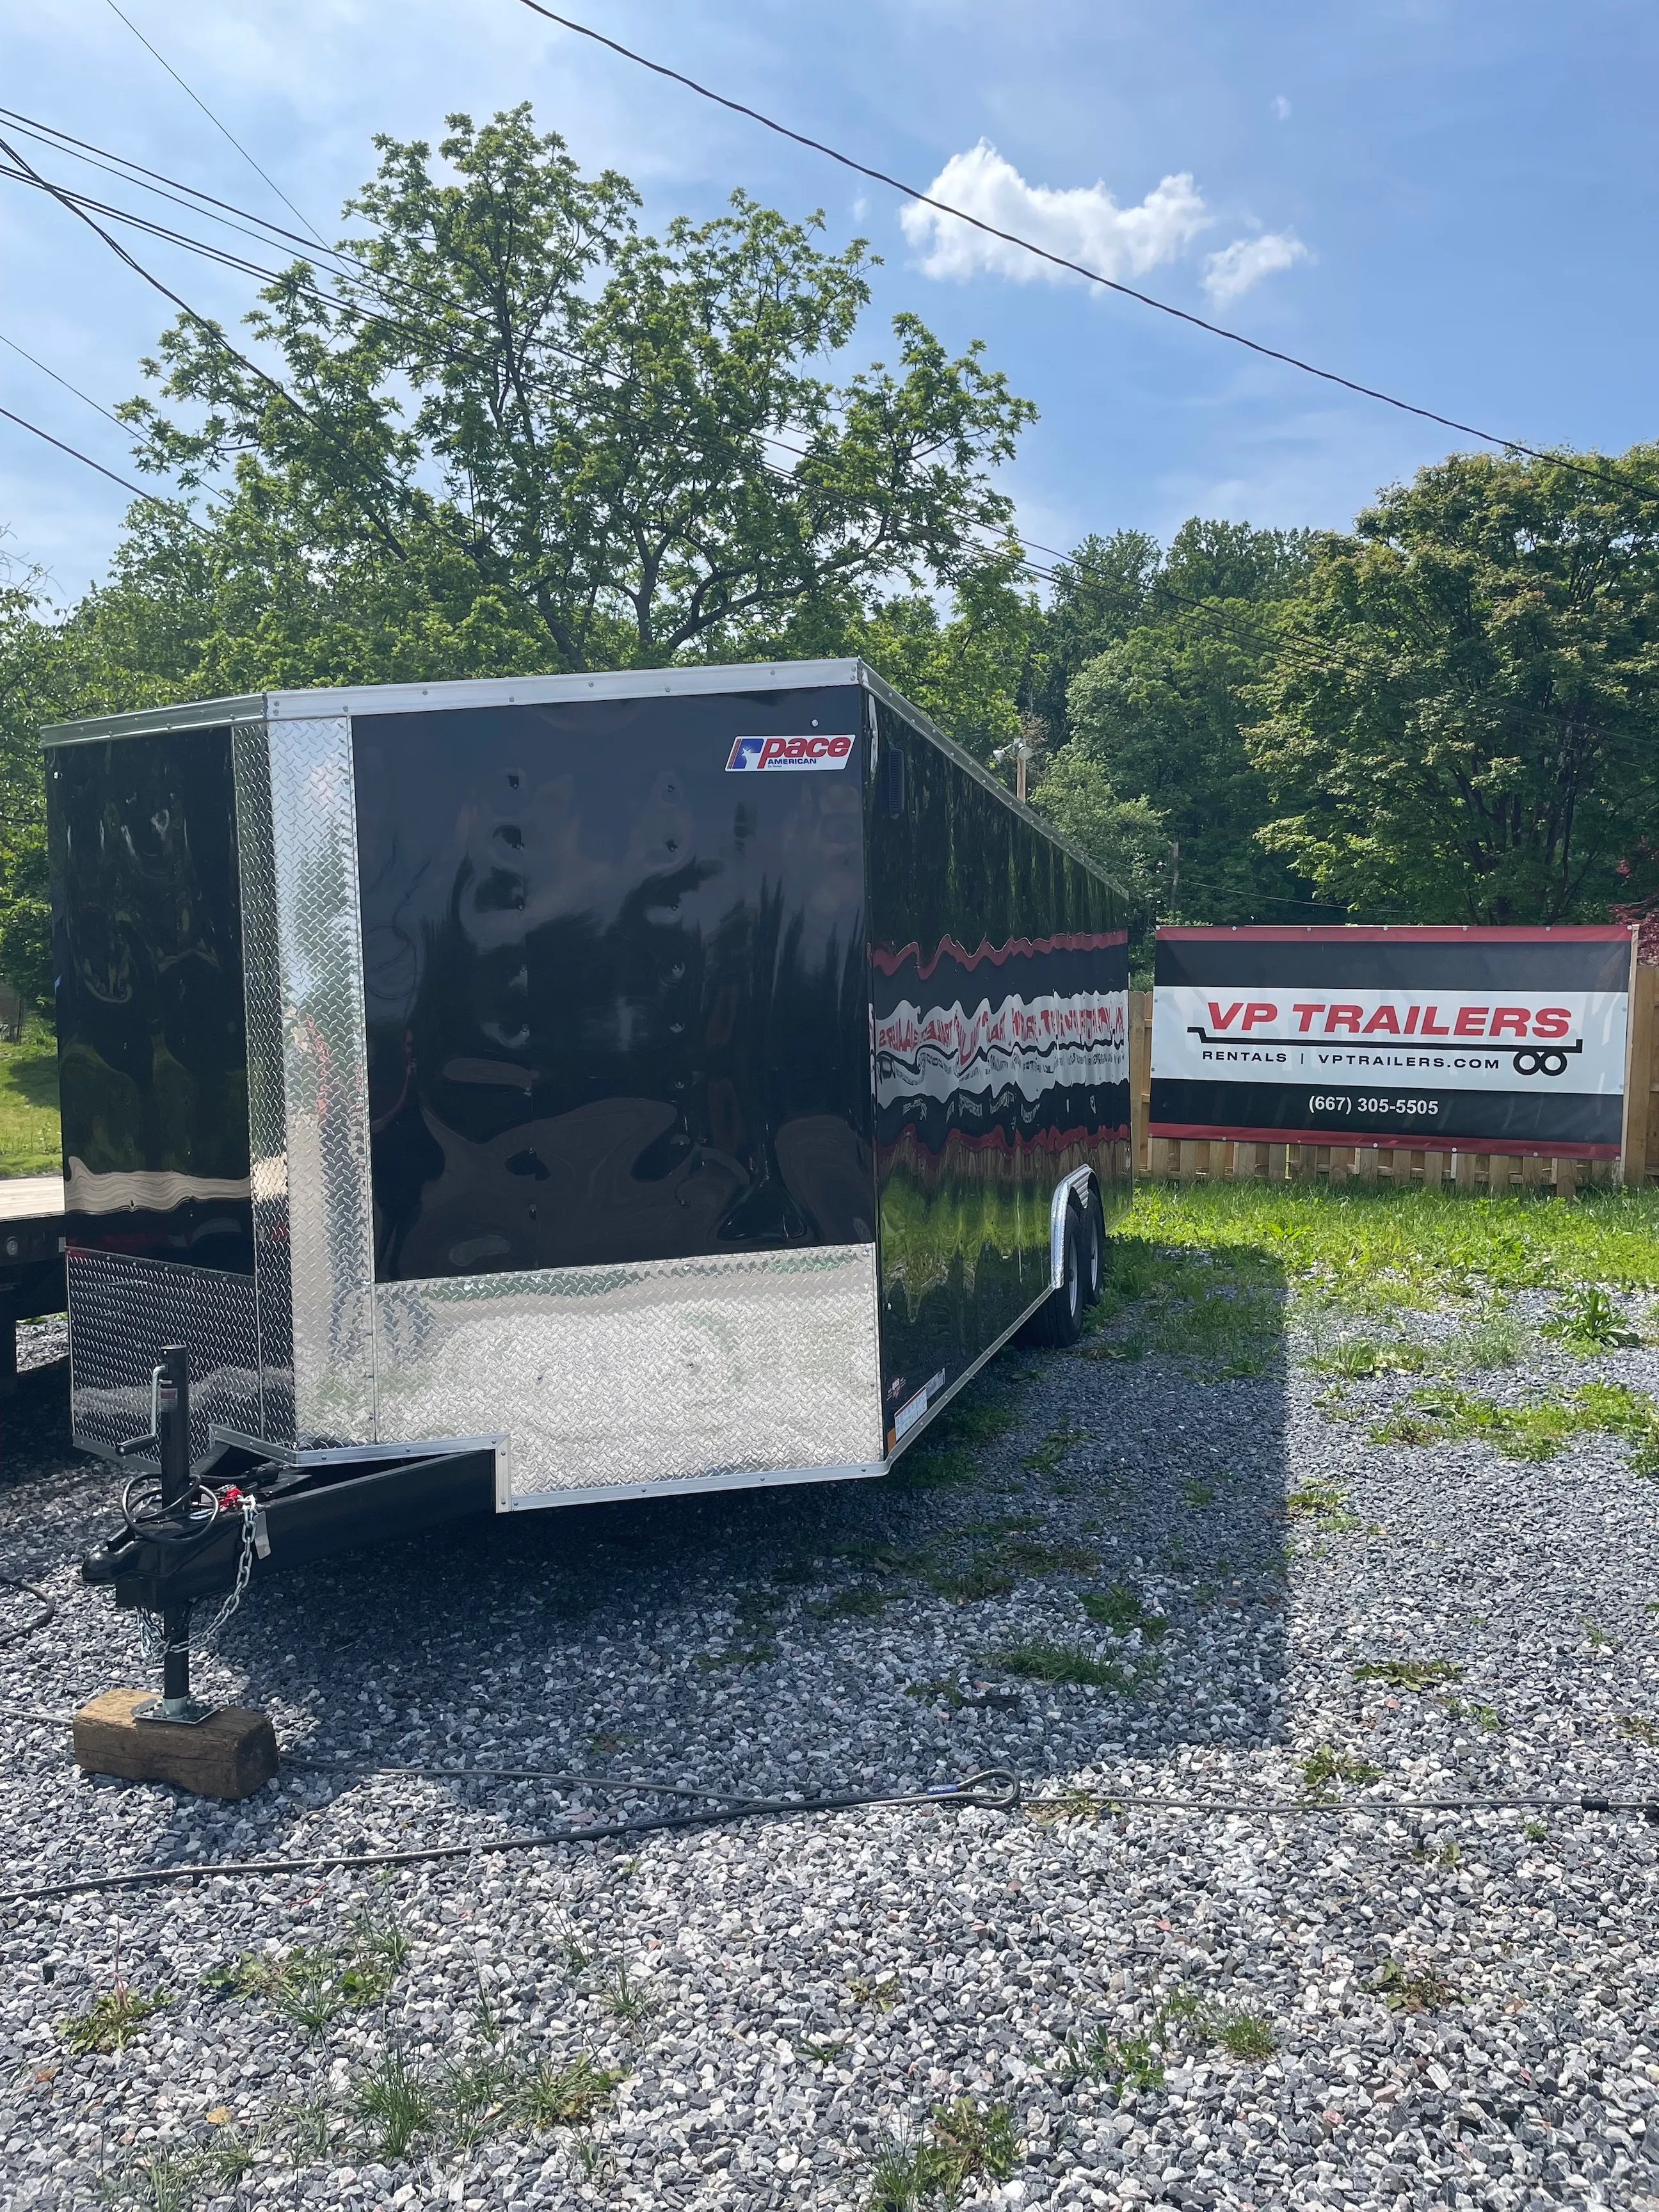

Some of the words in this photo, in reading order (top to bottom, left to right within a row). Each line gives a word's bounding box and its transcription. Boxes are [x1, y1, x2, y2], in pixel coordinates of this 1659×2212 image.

[757, 737, 851, 769] pace
[1207, 1002, 1278, 1030] VP
[1292, 1004, 1572, 1038] TRAILERS
[1202, 1050, 1287, 1062] RENTALS
[1318, 1054, 1500, 1070] VPTRAILERS.COM
[1308, 1095, 1352, 1115] (667)
[1357, 1097, 1439, 1116] 305-5505
